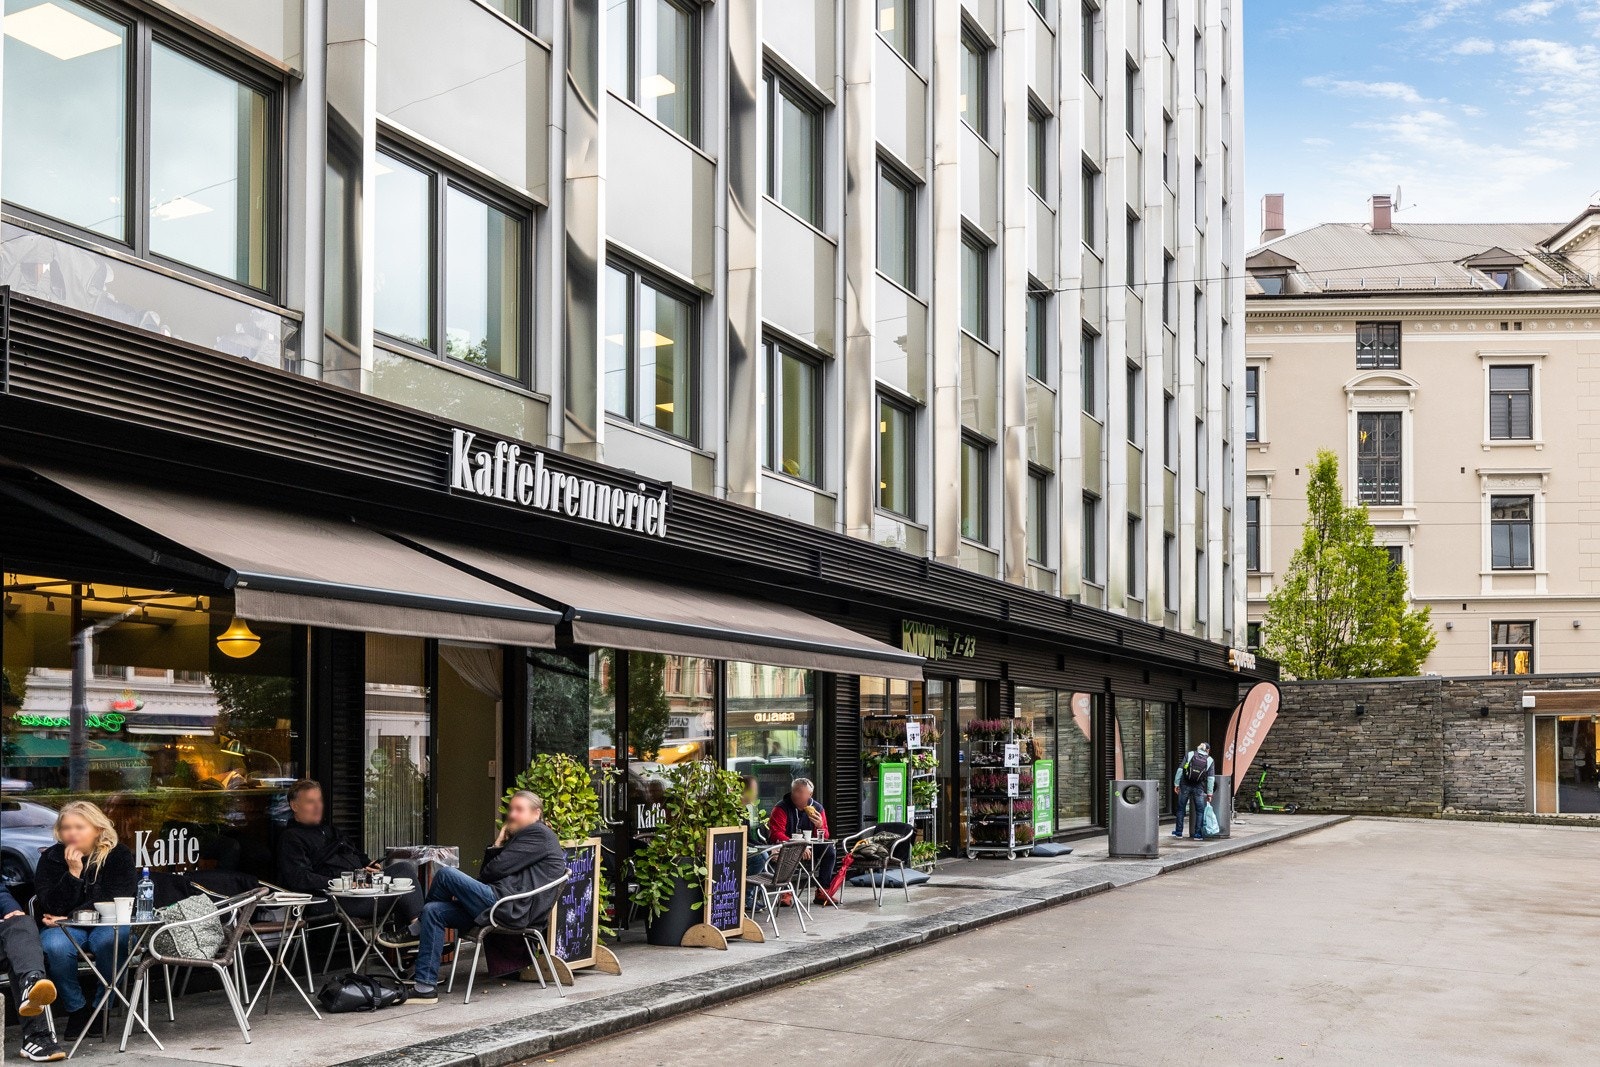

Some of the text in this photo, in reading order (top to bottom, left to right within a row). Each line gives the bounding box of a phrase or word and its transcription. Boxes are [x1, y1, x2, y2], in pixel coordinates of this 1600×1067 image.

[450, 427, 668, 538] Kaffebrenneriet
[902, 618, 935, 659] KIWI
[1238, 692, 1274, 755] squeeze
[134, 827, 200, 868] Kaffe
